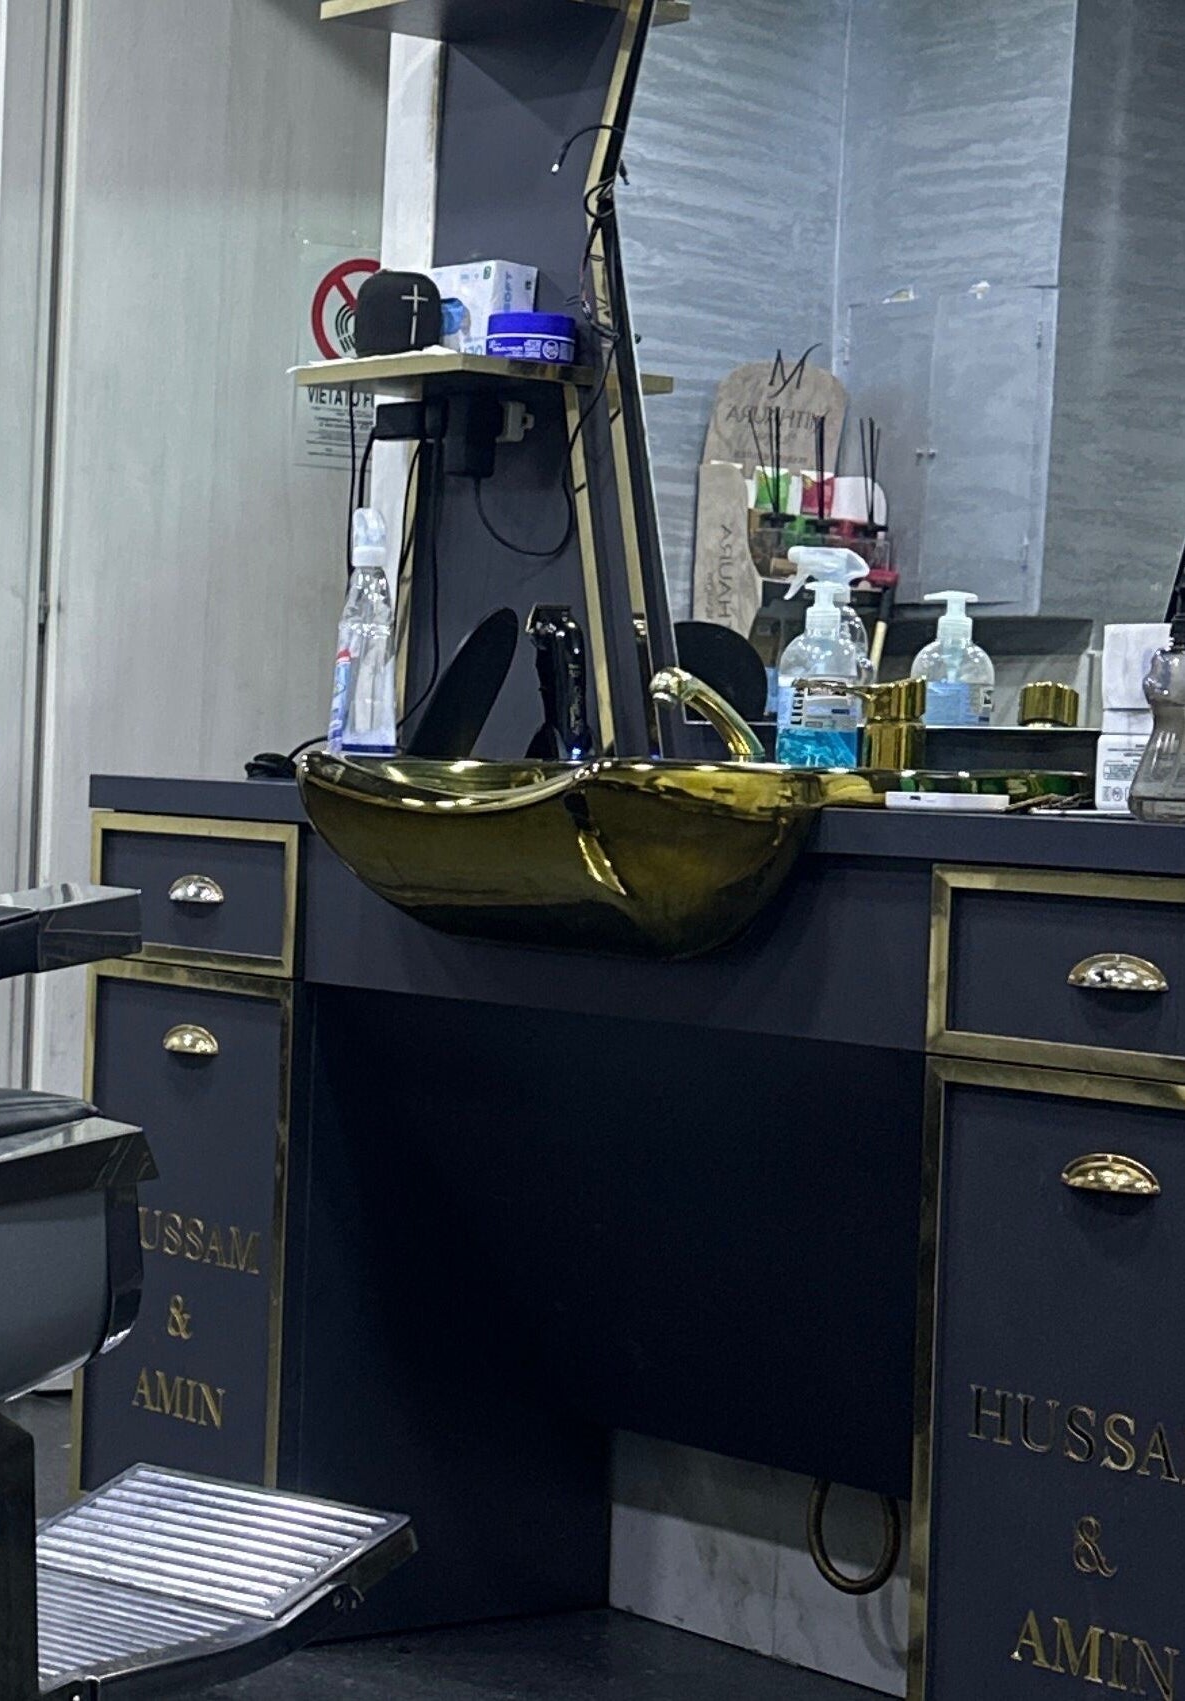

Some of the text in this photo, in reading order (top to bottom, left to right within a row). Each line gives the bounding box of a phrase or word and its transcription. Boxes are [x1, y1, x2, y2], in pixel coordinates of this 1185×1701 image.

[138, 1206, 260, 1275] USSAM
[166, 1294, 193, 1341] &
[131, 1367, 226, 1431] AMIN
[967, 1384, 1185, 1486] HUSSA
[1072, 1515, 1118, 1579] &
[1009, 1608, 1181, 1701] AMIN
